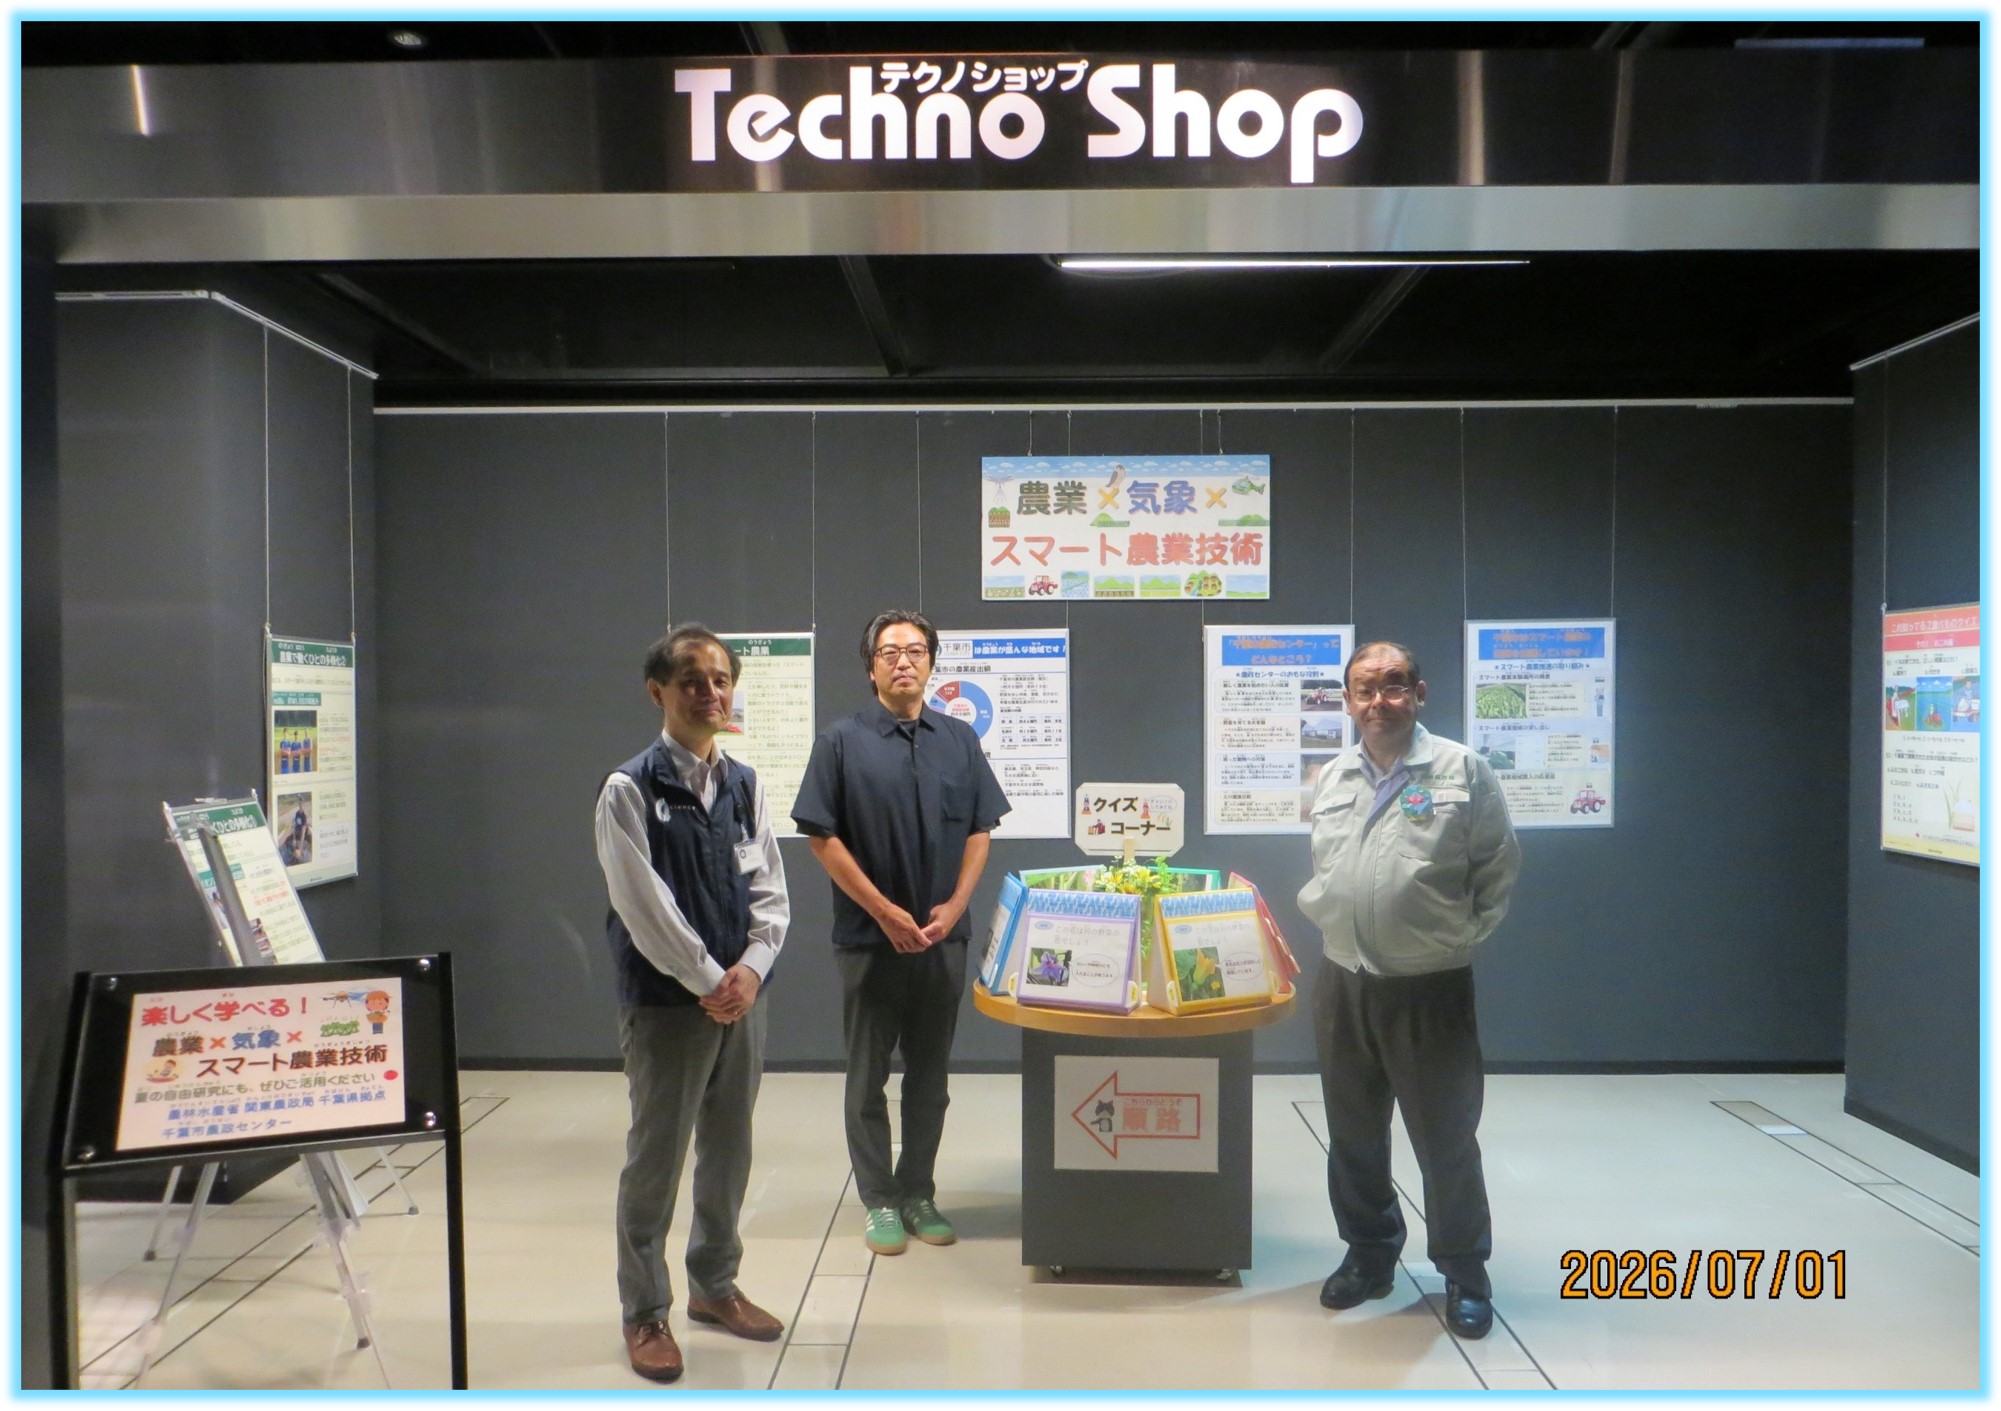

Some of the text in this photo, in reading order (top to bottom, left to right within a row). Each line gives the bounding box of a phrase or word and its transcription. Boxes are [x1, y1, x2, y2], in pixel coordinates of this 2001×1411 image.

[880, 61, 1088, 92] テクノショップ
[674, 63, 1364, 183] Techno Shop
[990, 531, 1264, 566] スマート農業技術
[943, 642, 971, 652] 千葉市
[1093, 796, 1138, 813] クイズ
[1111, 820, 1171, 836] コーナー
[141, 996, 309, 1028] 楽しく学べる！
[196, 1043, 388, 1078] スマート農業技術
[161, 1119, 292, 1139] 千葉市農政センター
[1122, 1107, 1181, 1131] 順路
